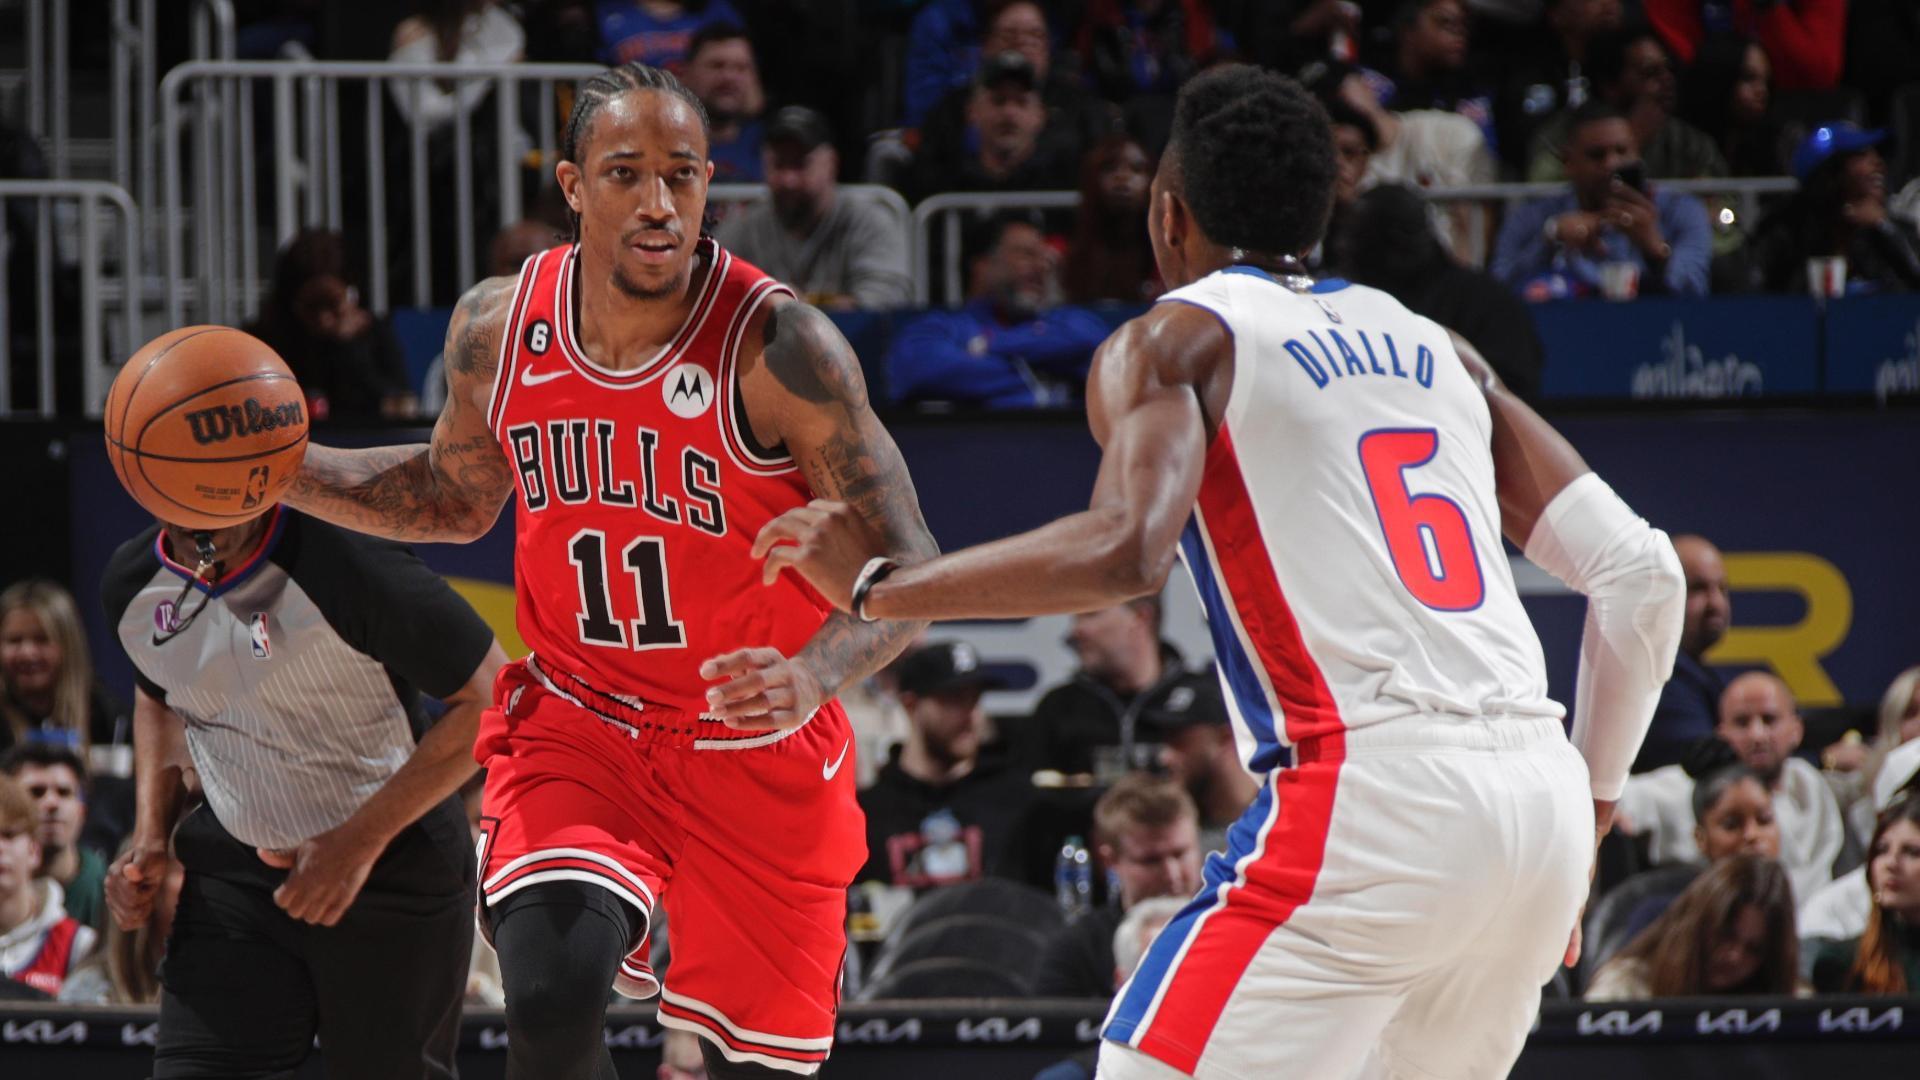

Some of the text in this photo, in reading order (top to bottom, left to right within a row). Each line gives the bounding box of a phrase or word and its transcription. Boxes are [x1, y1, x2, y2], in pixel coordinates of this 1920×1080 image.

[530, 322, 549, 352] 6
[1282, 329, 1434, 389] DIALLO
[184, 397, 304, 445] Wilson
[507, 419, 728, 538] BULLS
[1357, 427, 1486, 613] 6
[567, 528, 688, 652] 11
